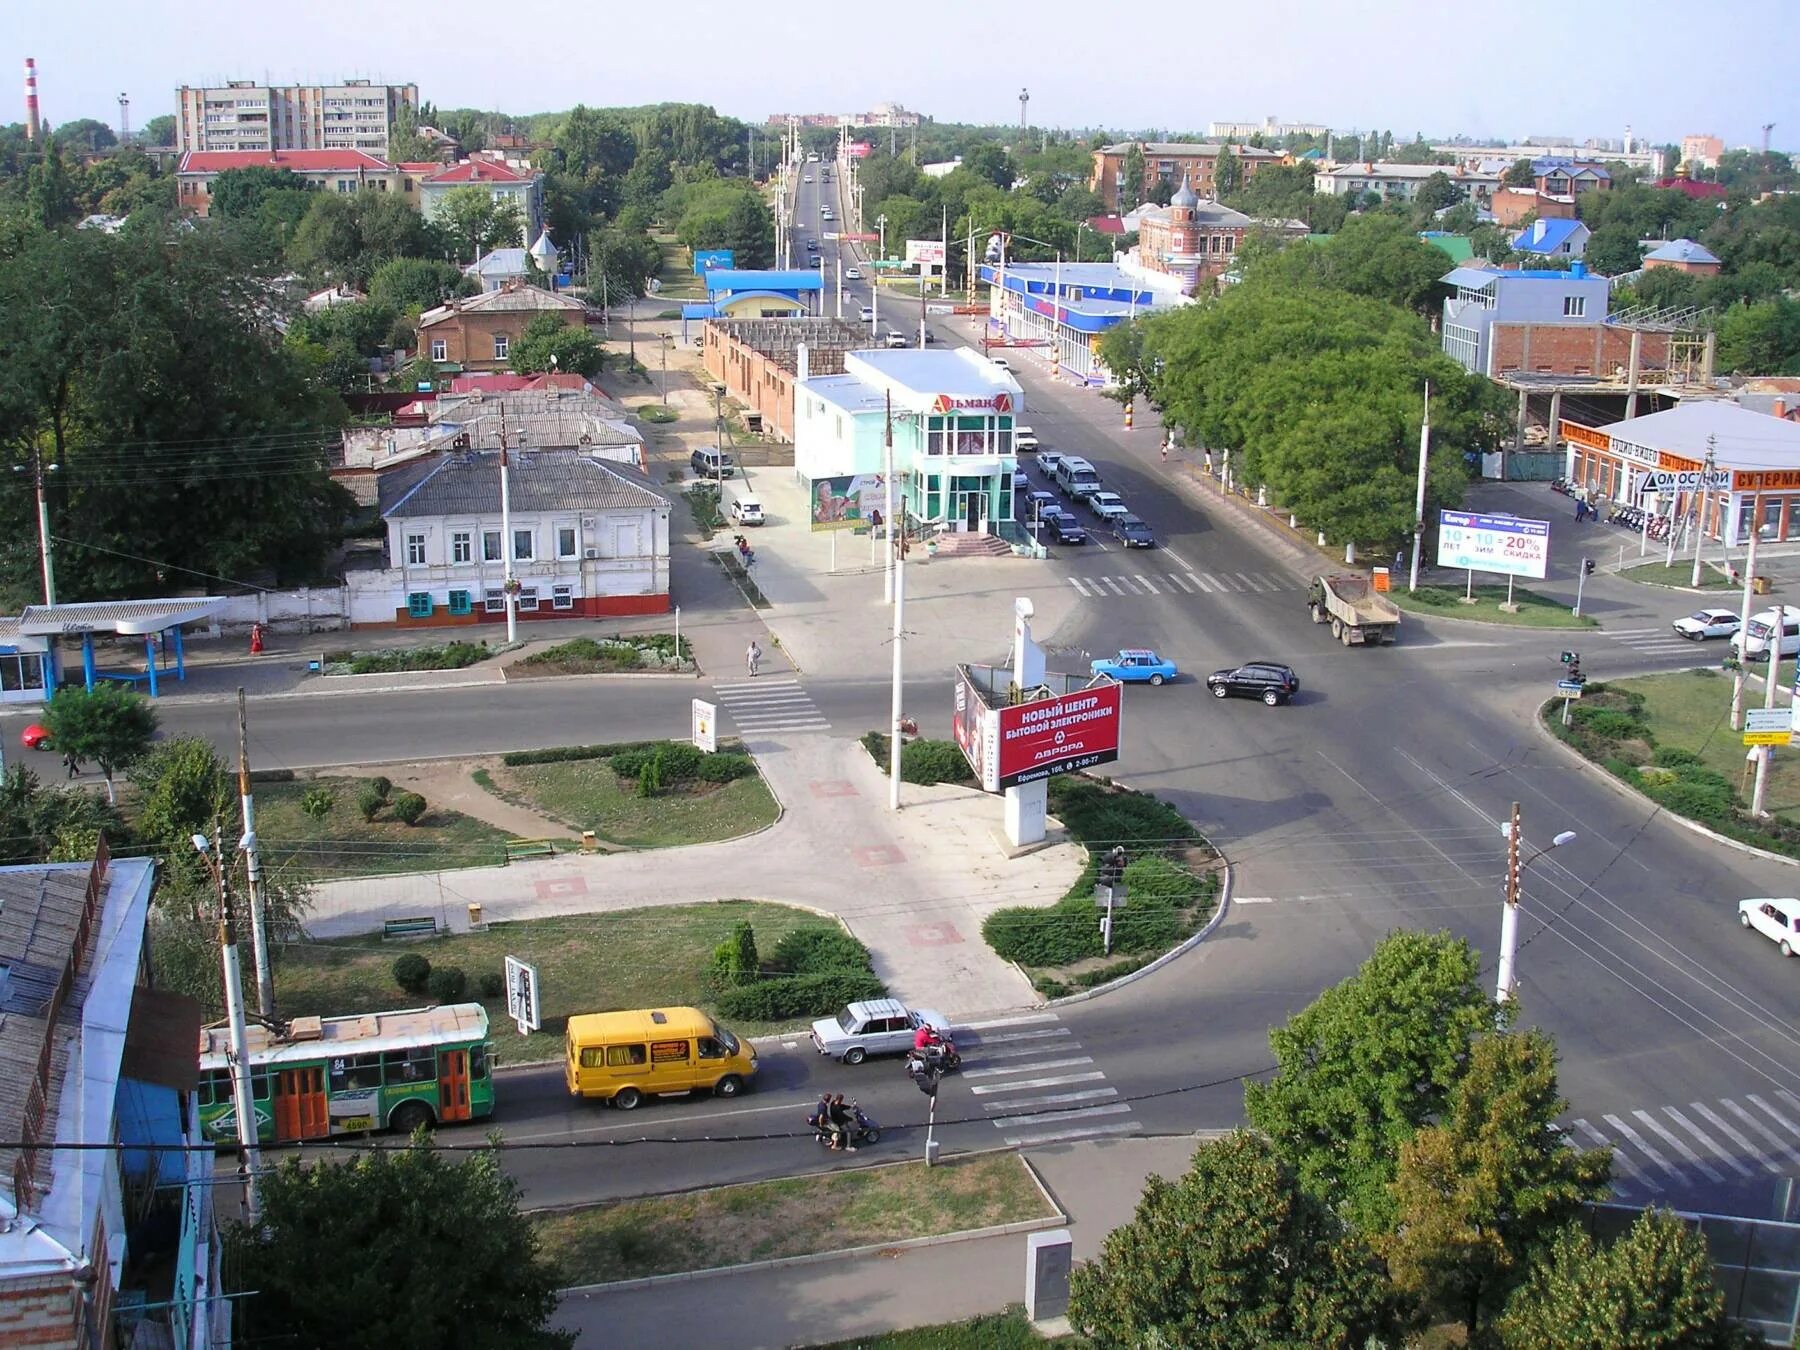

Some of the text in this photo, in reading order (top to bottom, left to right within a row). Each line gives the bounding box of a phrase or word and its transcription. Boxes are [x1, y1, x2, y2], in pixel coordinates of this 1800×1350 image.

[1444, 542, 1541, 560] ЛЕТ ЗИМ СКИДКА
[1507, 536, 1540, 551] 20%
[1022, 697, 1098, 724] НОВЫЙ ЦЕНТР
[1006, 706, 1113, 740] БЫТОВОЙ ЭЛЕКТРОНИКИ
[1034, 742, 1084, 760] АВРОРА
[334, 1059, 345, 1070] 84
